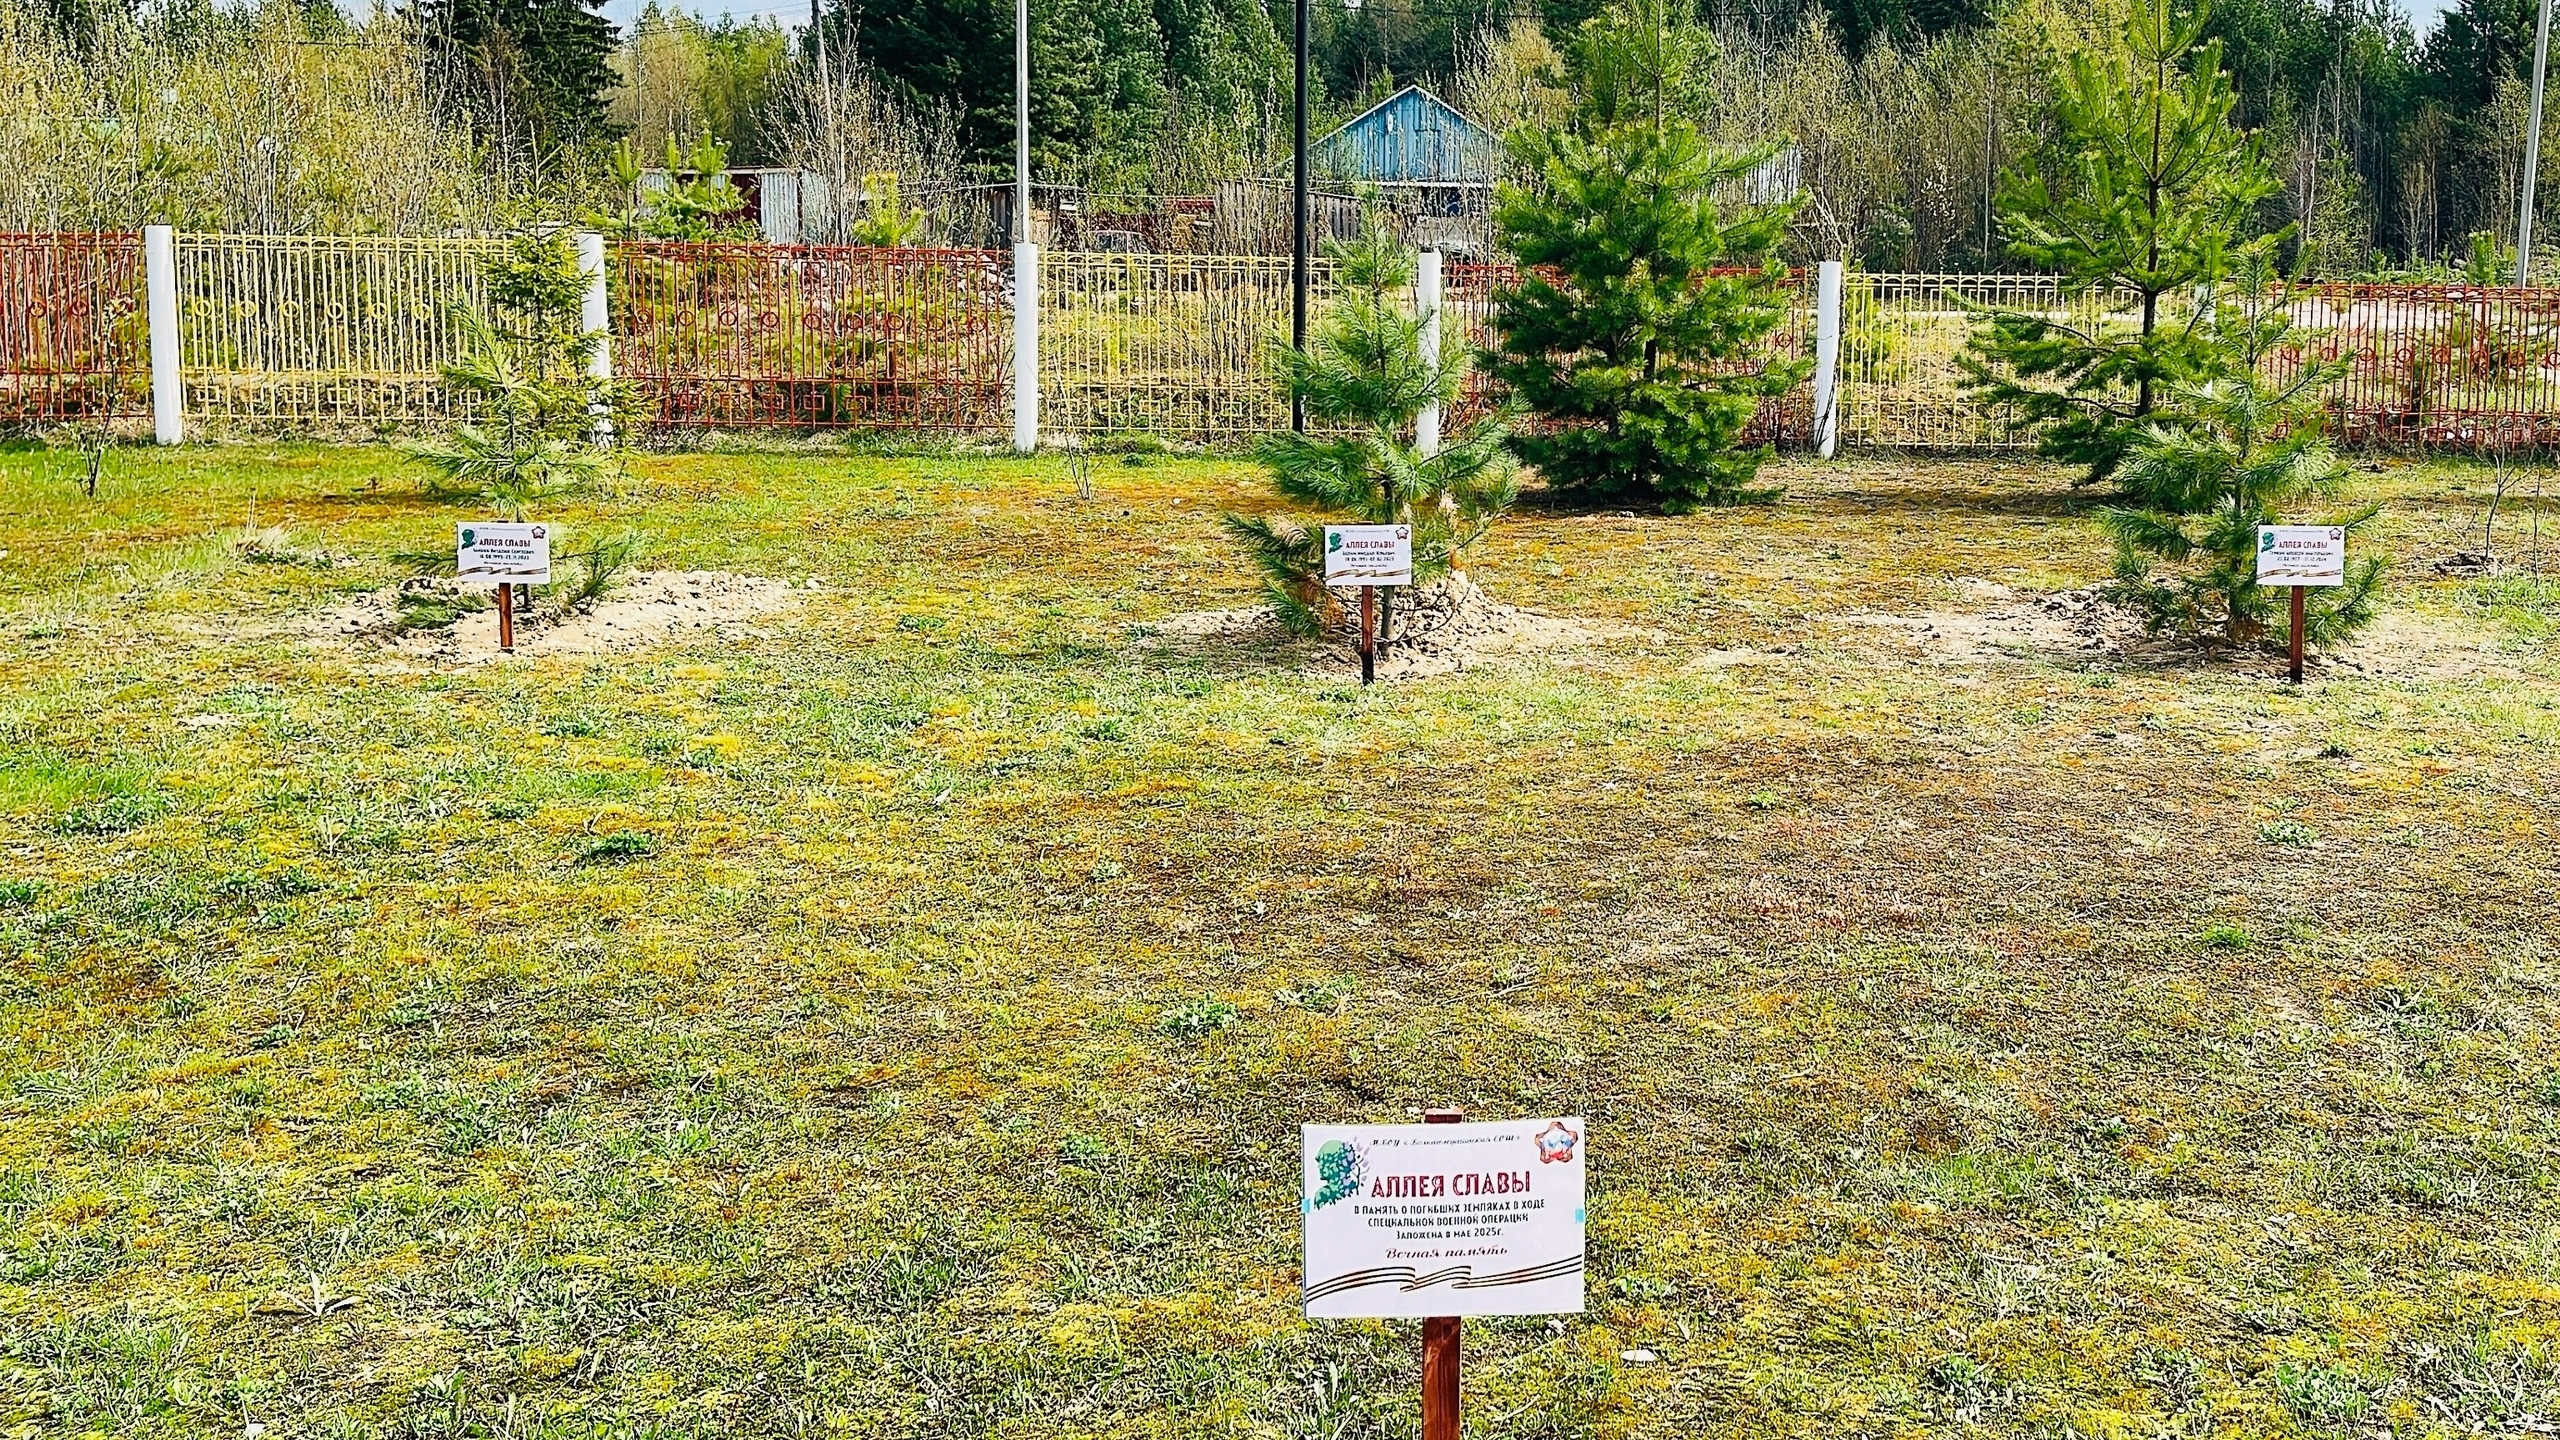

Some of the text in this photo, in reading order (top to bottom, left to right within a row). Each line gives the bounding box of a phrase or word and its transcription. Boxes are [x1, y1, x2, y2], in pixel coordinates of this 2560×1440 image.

[479, 539, 530, 547] АЛЛЕЯ СЛАВЫ
[1371, 1171, 1531, 1198] АЛЛЕЯ СЛАВЫ
[1354, 1199, 1545, 1215] В ПАМЯТЬ О ПОГИБШИХ ЗЕМЛЯКАХ В ХОДЕ
[1368, 1213, 1529, 1228] СПЕЦИАЛЬНОЙ ВОЕННОЙ ОПЕРАЦИИ
[1396, 1230, 1443, 1240] ЗАЛОЖЕНА
[1445, 1230, 1451, 1238] В
[1454, 1229, 1471, 1238] МАЕ
[1385, 1245, 1508, 1259] Вечная память
